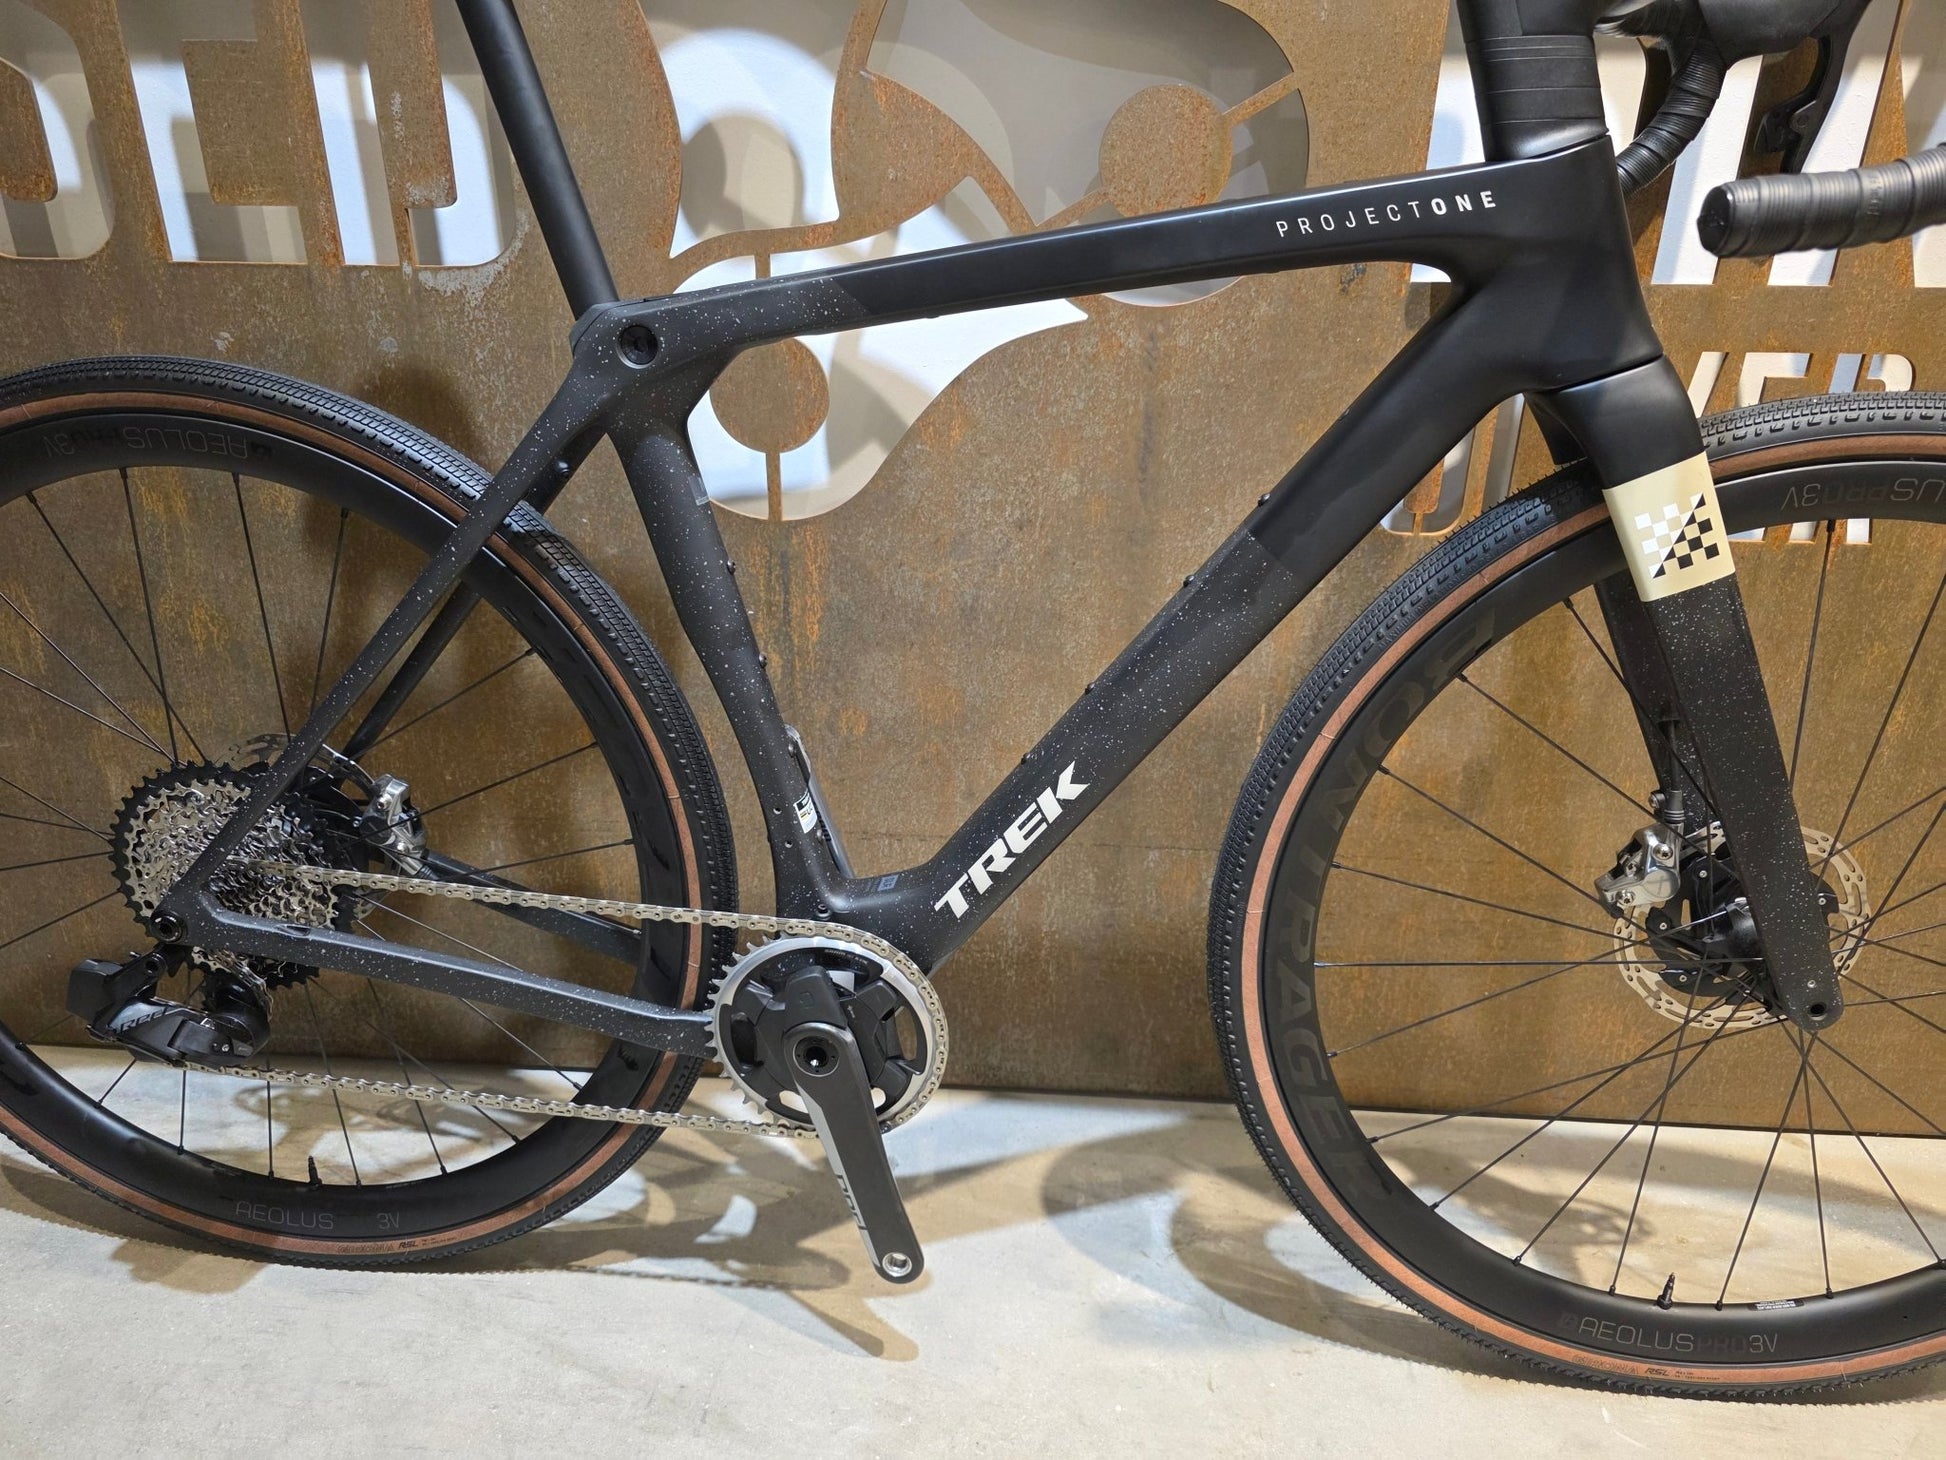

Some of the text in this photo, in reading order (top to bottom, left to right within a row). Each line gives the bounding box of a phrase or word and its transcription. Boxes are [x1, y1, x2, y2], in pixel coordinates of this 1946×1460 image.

[123, 427, 248, 459] AEOLUS
[1782, 483, 1821, 511] 3V
[934, 760, 1091, 919] TREK
[235, 1200, 400, 1230] AEOLUS 3V
[1578, 1316, 1695, 1353] AEOLUS
[1749, 1332, 1778, 1354] 3V
[1644, 1366, 1670, 1377] RSL
